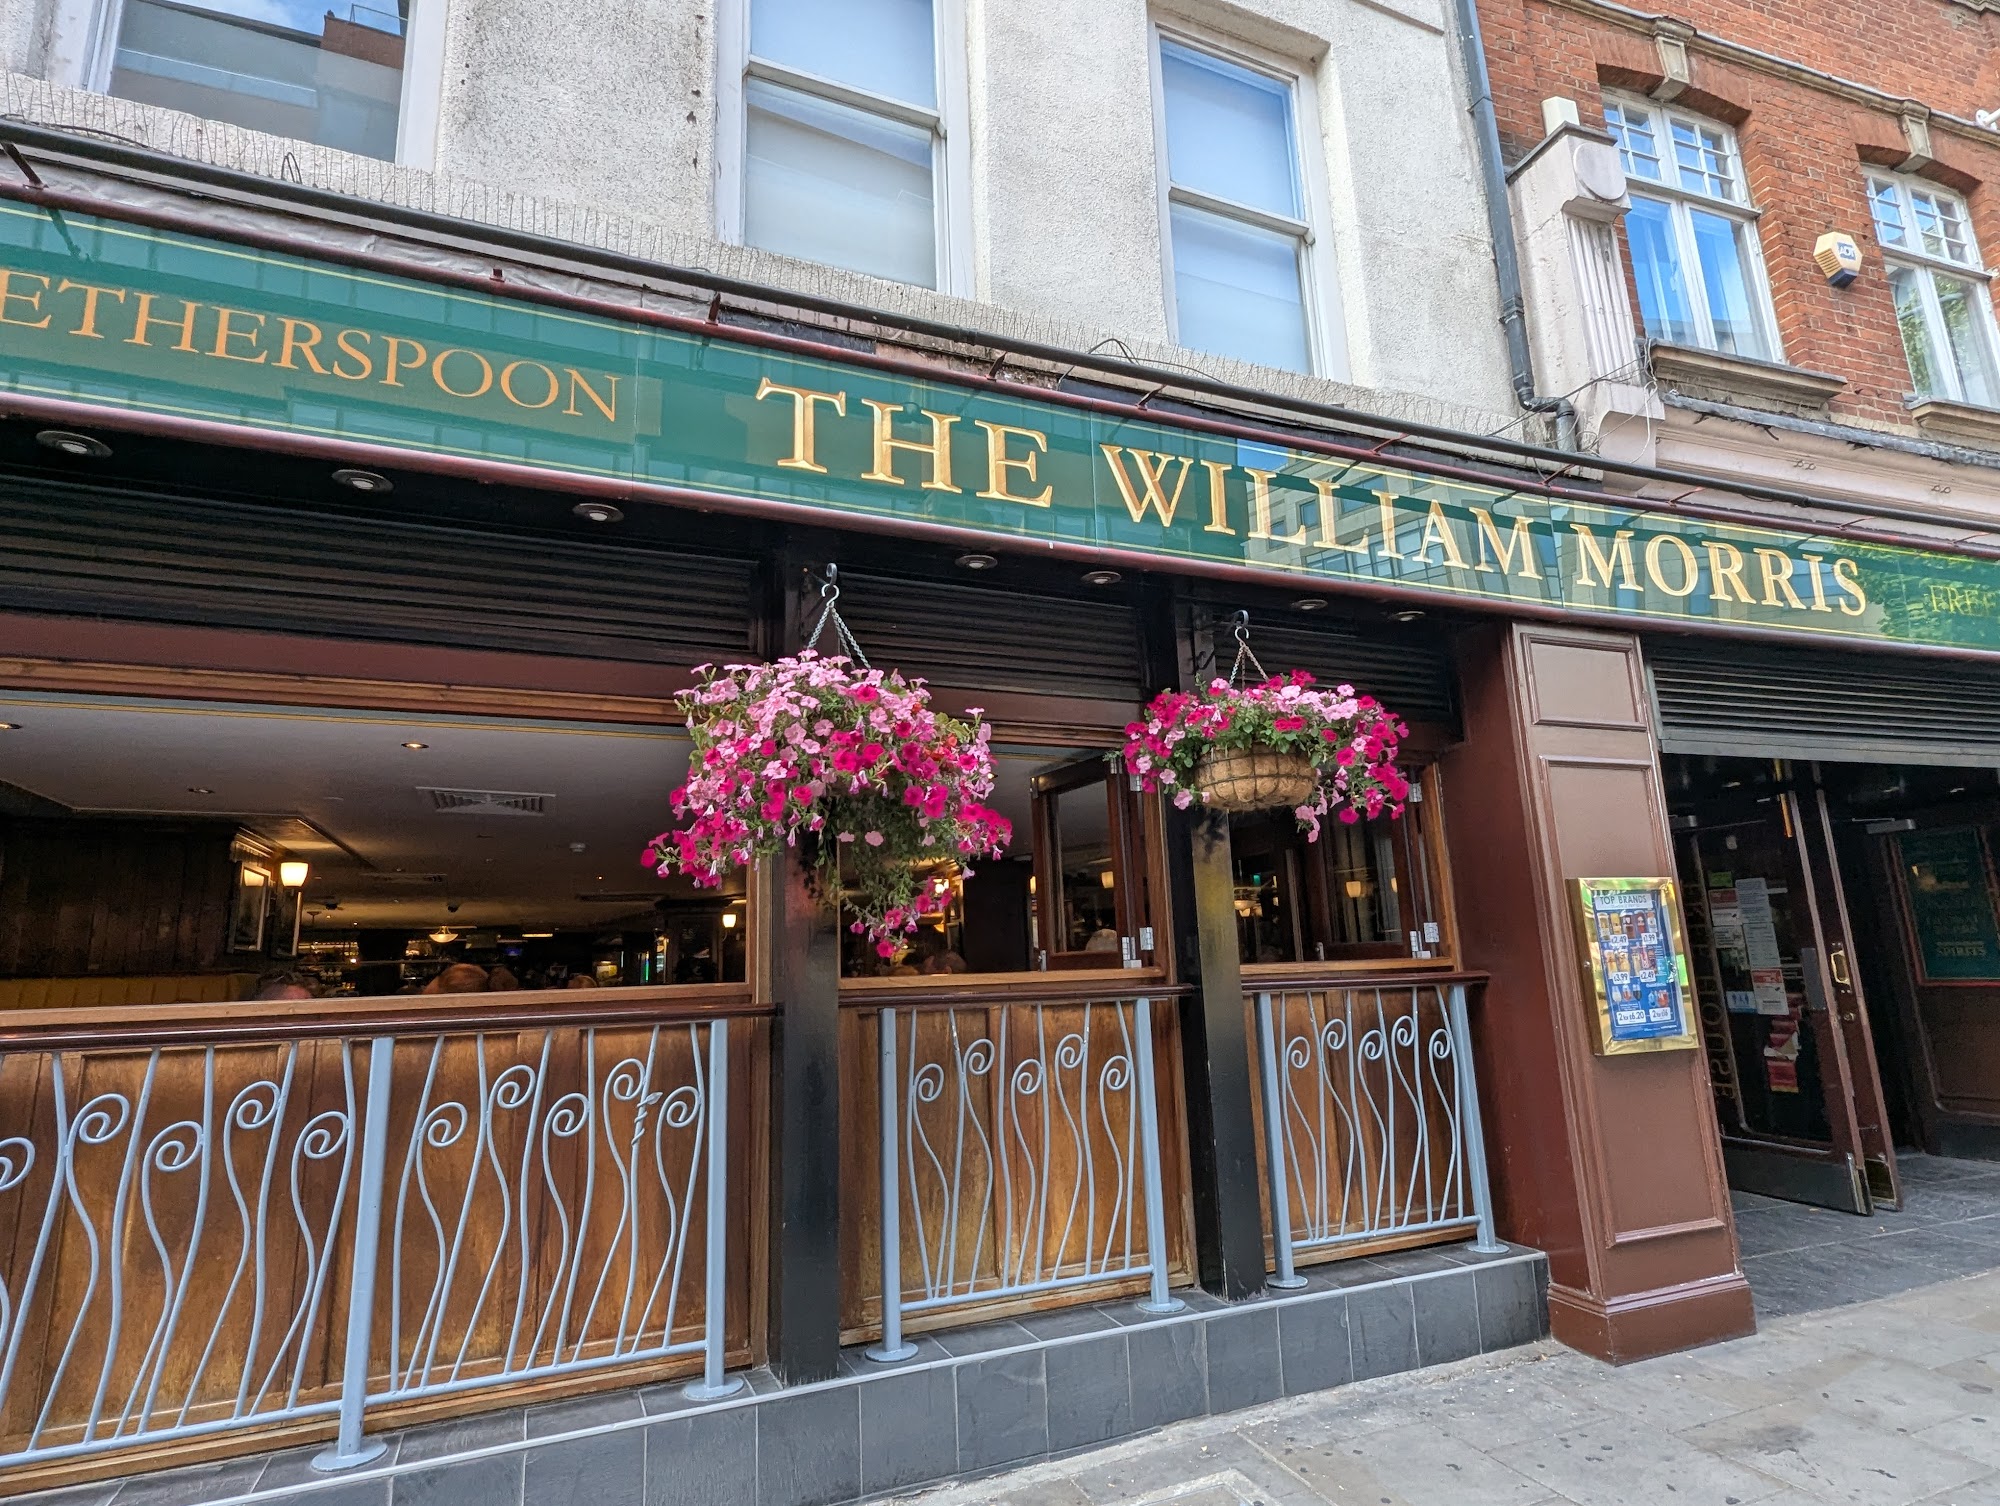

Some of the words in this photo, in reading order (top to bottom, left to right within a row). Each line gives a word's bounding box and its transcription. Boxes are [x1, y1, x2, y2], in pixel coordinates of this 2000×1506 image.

[756, 377, 1052, 508] THE
[1100, 444, 1543, 581] WILLIAM
[1569, 523, 1867, 617] MORRIS
[1600, 896, 1615, 905] TOP
[1618, 895, 1647, 904] BRANDS
